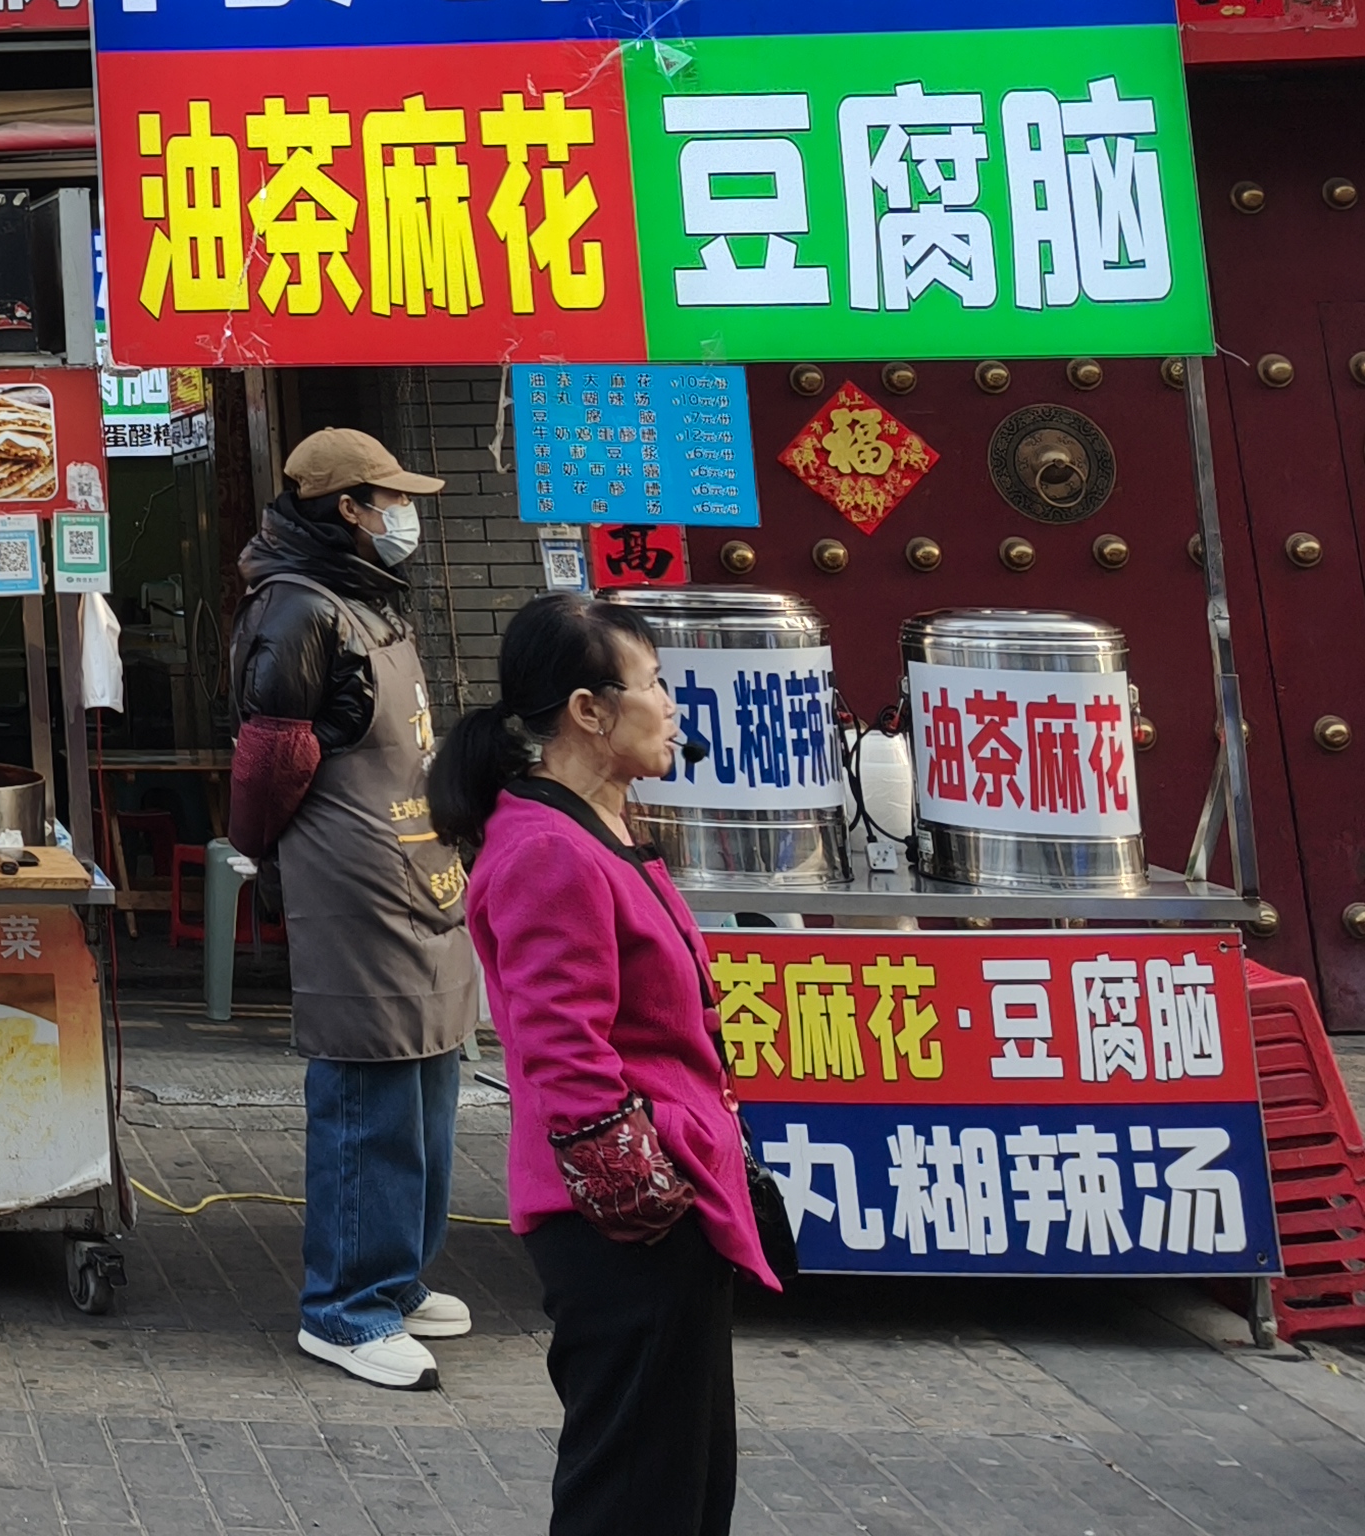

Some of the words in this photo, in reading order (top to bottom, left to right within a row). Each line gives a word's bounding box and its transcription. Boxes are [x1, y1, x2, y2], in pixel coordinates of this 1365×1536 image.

[136, 92, 607, 318] 油茶麻花
[661, 74, 1175, 316] 豆腐脑
[532, 409, 656, 424] 豆腐脑
[822, 408, 894, 475] 福
[922, 687, 1129, 814] 油茶麻花
